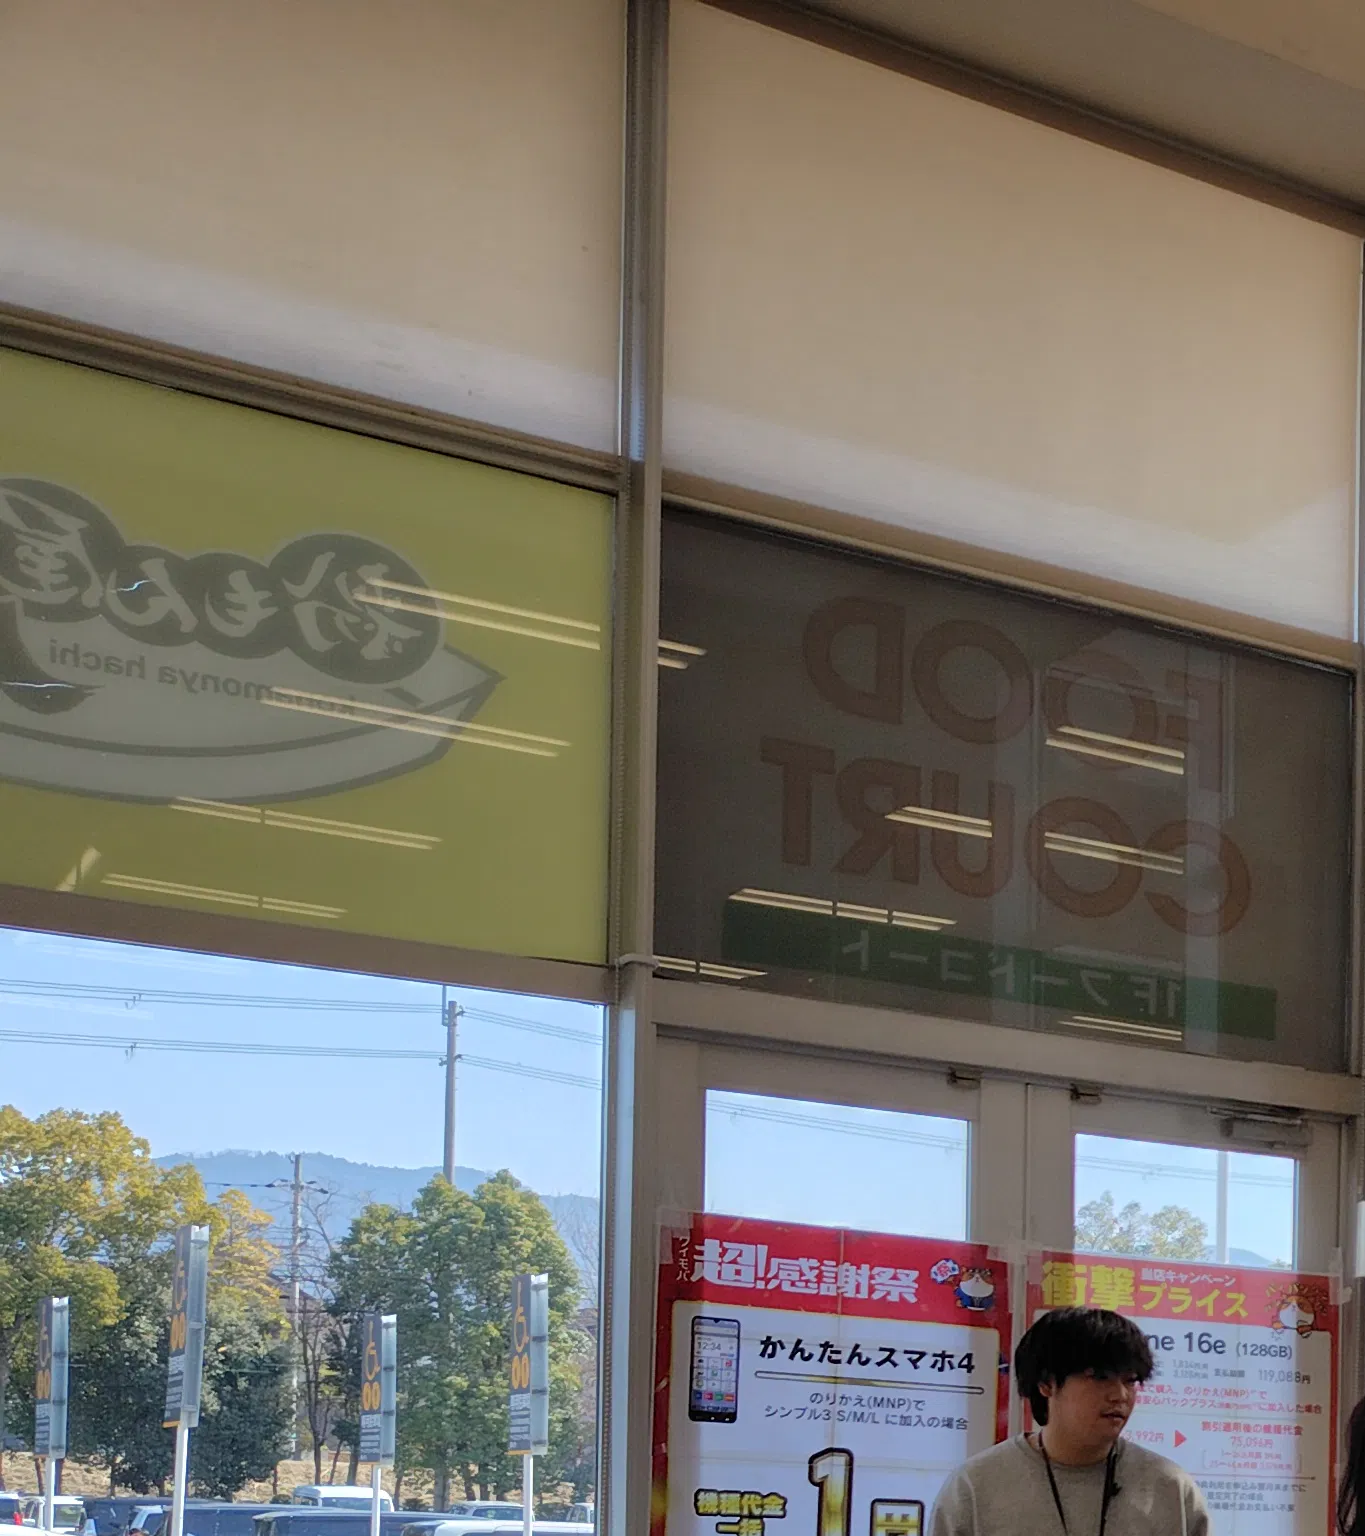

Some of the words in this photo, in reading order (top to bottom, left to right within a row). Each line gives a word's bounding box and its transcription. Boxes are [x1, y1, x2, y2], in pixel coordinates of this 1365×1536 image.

[1041, 1260, 1135, 1311] 衝撃
[1140, 1282, 1249, 1319] プライス
[759, 1335, 976, 1374] かんたんスマホ4
[1184, 1332, 1227, 1355] 16e
[1236, 1342, 1293, 1360] (128GB)
[1258, 1369, 1311, 1385] 119,088円
[809, 1391, 927, 1413] のりかえ(MNP)で
[1122, 1430, 1164, 1443] 3,992円
